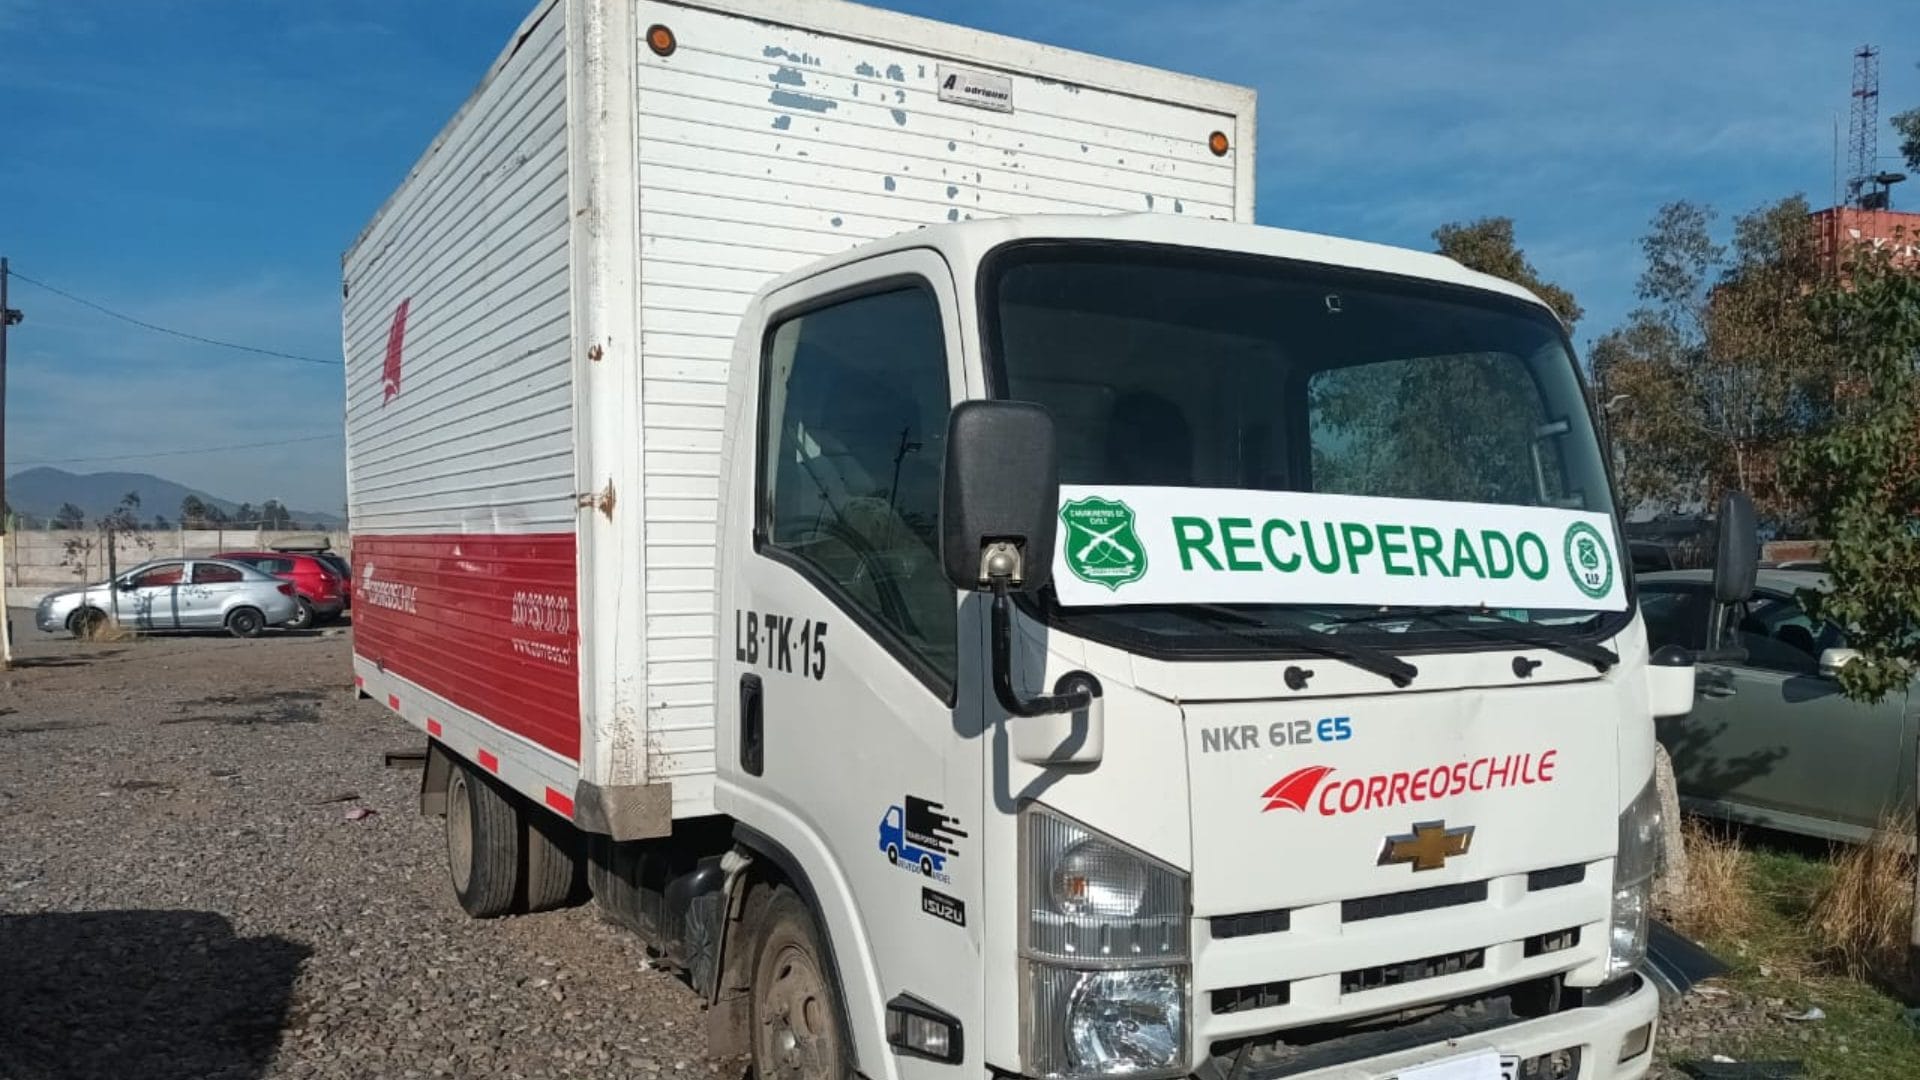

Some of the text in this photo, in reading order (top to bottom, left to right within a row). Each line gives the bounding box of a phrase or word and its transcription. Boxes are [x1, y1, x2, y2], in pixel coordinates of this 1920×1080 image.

[1171, 516, 1549, 581] RECUPERADO
[1201, 717, 1352, 753] NKR 612 E5
[1318, 749, 1557, 816] CORREOSCHILE
[924, 898, 962, 922] ISUZU
